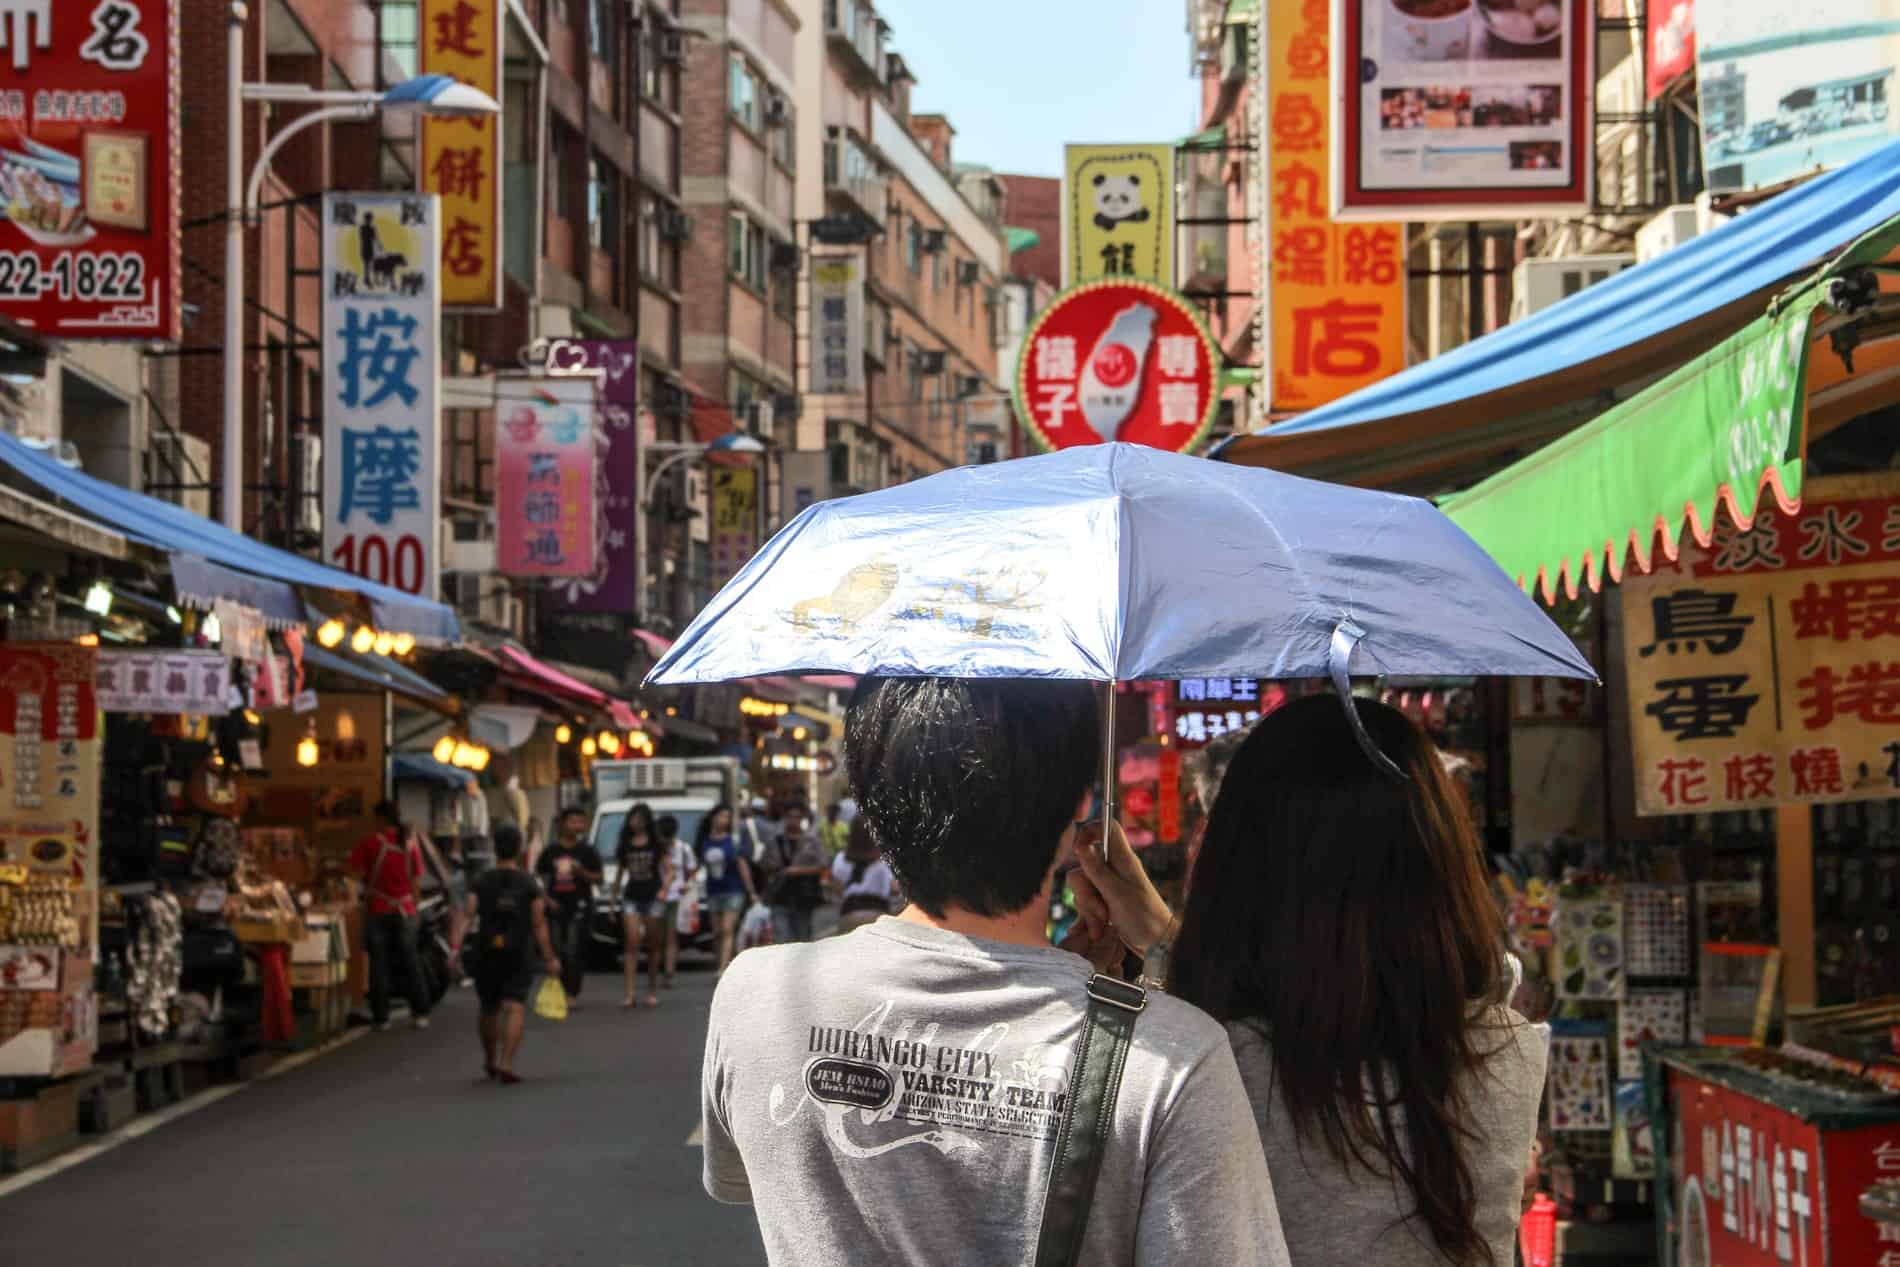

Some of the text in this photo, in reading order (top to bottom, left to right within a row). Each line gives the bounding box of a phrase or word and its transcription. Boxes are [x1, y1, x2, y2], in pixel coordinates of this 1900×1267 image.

[1292, 298, 1384, 380] 店
[336, 307, 420, 525] 按摩
[332, 532, 425, 597] 100
[1656, 746, 1844, 807] 花枝燒
[808, 1026, 999, 1079] DURANGO CITY
[900, 1091, 951, 1112] ARIZONA
[952, 1101, 995, 1118] STATE
[902, 1070, 1066, 1113] VARSITY TEAM
